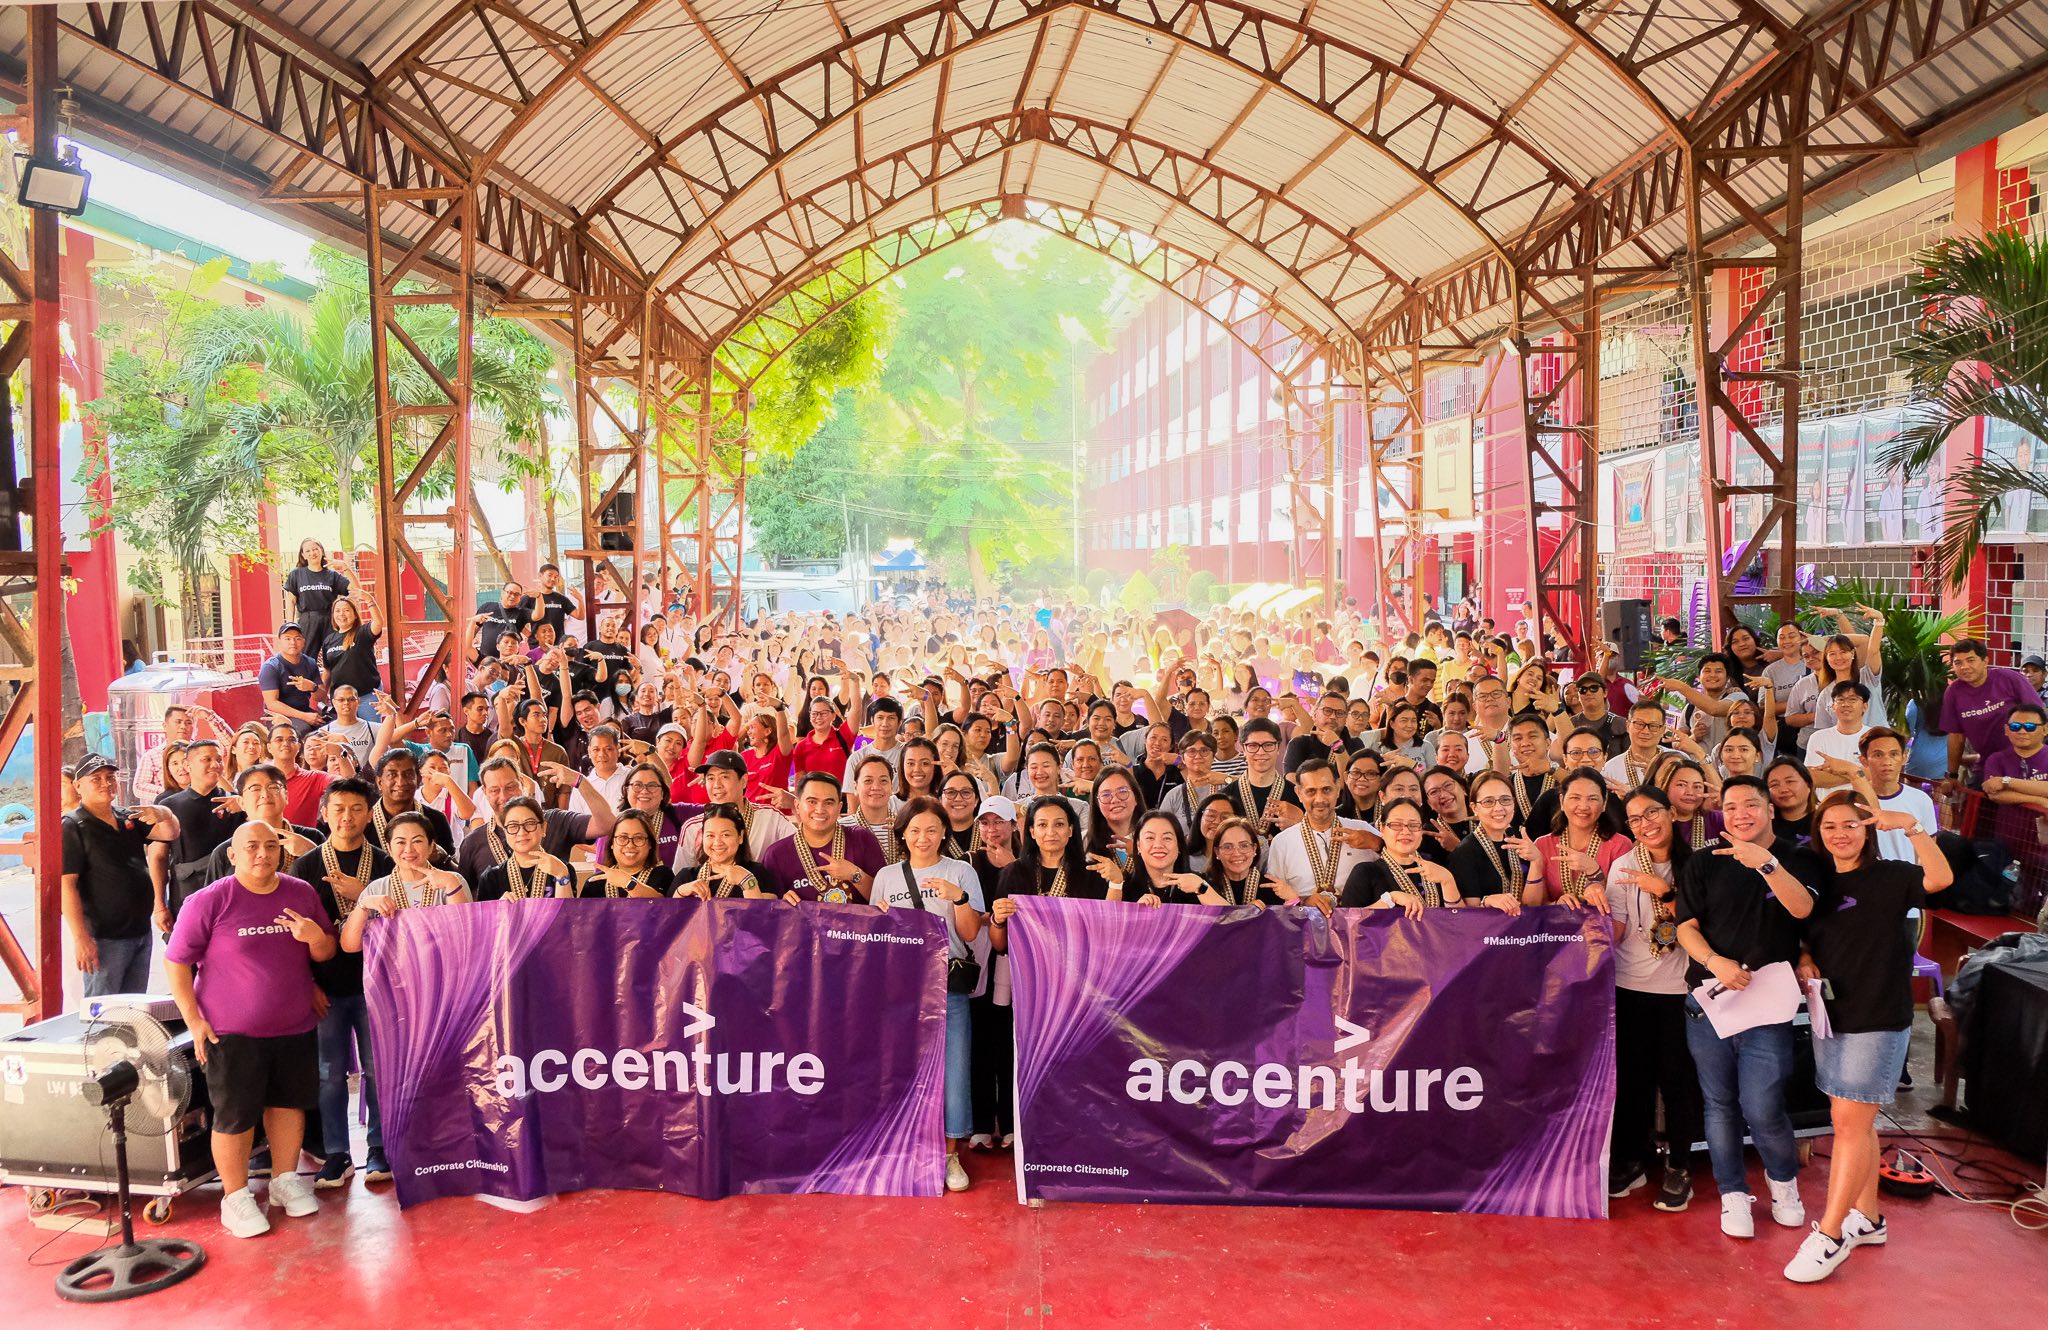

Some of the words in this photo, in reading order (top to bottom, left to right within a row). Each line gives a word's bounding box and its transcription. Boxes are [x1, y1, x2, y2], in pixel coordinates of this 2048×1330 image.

[1961, 701, 2005, 718] accenture
[826, 930, 925, 945] #MakingADifference
[1483, 933, 1584, 946] #MakingADifference
[495, 1042, 825, 1098] accenture
[1125, 1056, 1484, 1113] accenture
[414, 1162, 464, 1176] Corporate
[466, 1159, 509, 1173] Citizenship
[1024, 1163, 1073, 1173] Corporate
[1074, 1164, 1129, 1177] Citizenship
